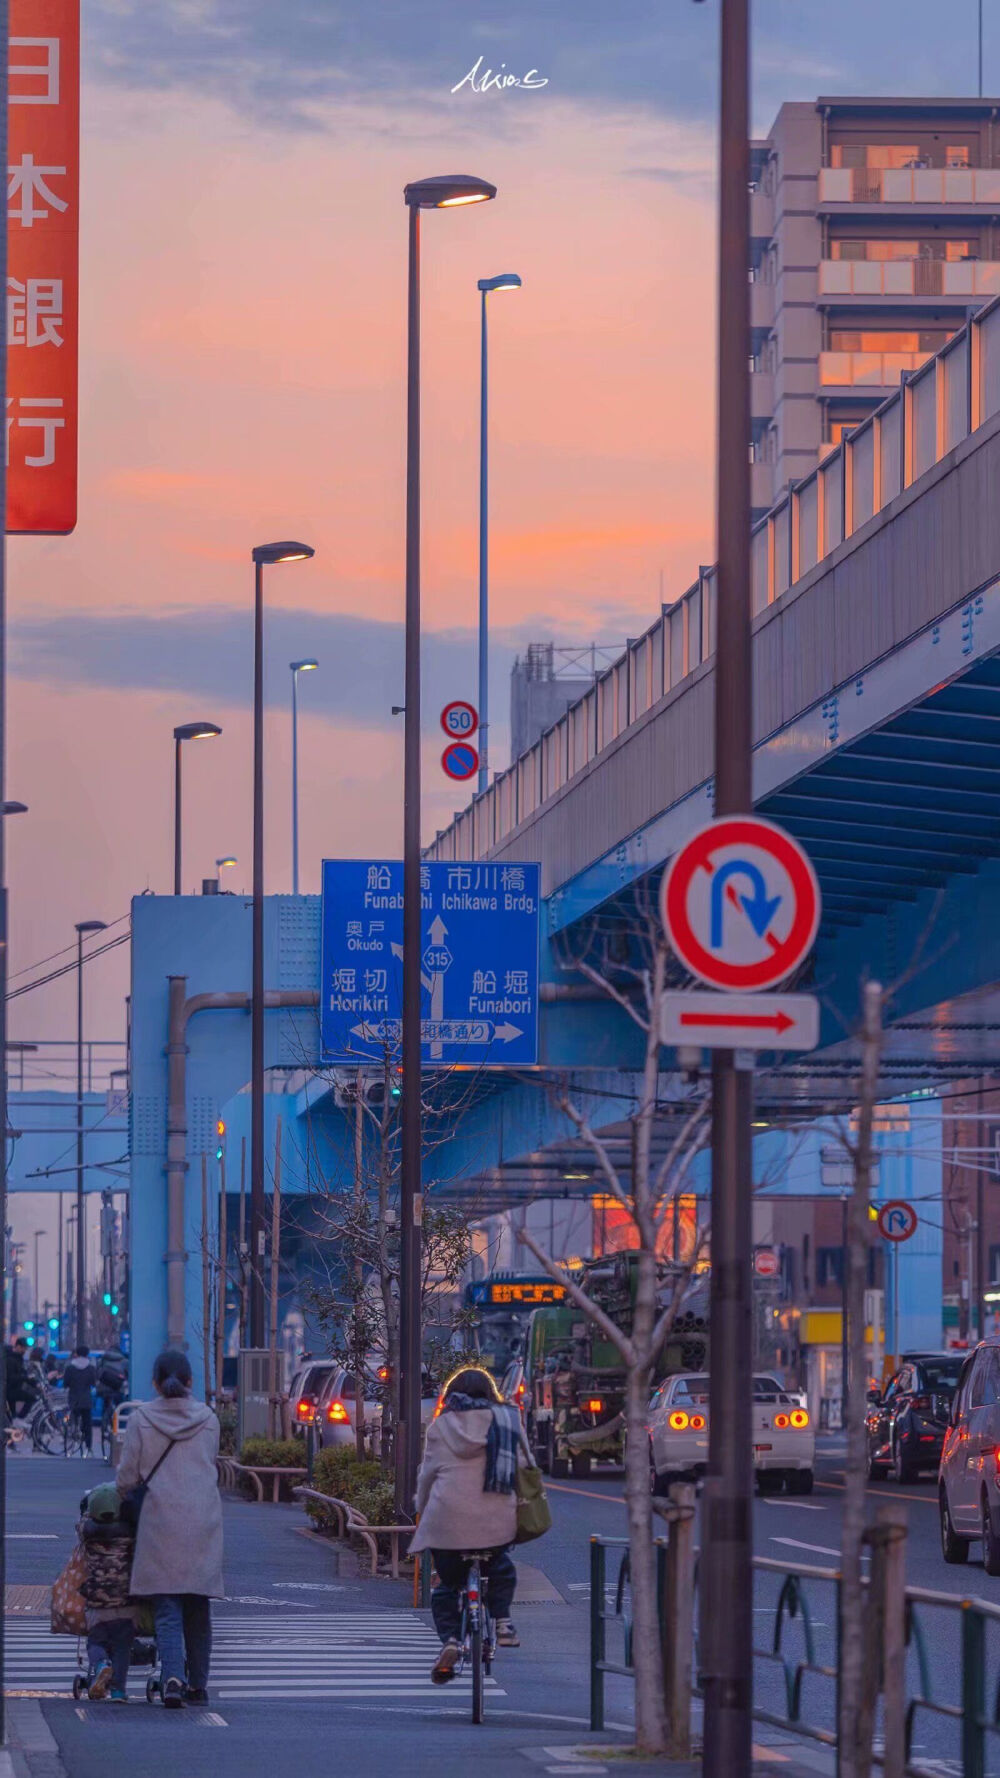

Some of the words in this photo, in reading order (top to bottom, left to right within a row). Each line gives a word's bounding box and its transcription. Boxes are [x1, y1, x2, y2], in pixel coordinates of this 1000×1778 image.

[449, 712, 470, 728] 50
[447, 866, 525, 891] 市川橋
[364, 892, 433, 910] Funabhi
[442, 893, 497, 910] Ichikawa
[504, 894, 537, 914] Brdg.
[346, 920, 385, 937] 奥戸
[347, 938, 383, 951] Okudo
[427, 952, 448, 966] 315
[332, 969, 387, 993] 堀切
[472, 970, 528, 995] 船堀
[330, 995, 388, 1012] Horikiri
[469, 997, 531, 1014] Funabori
